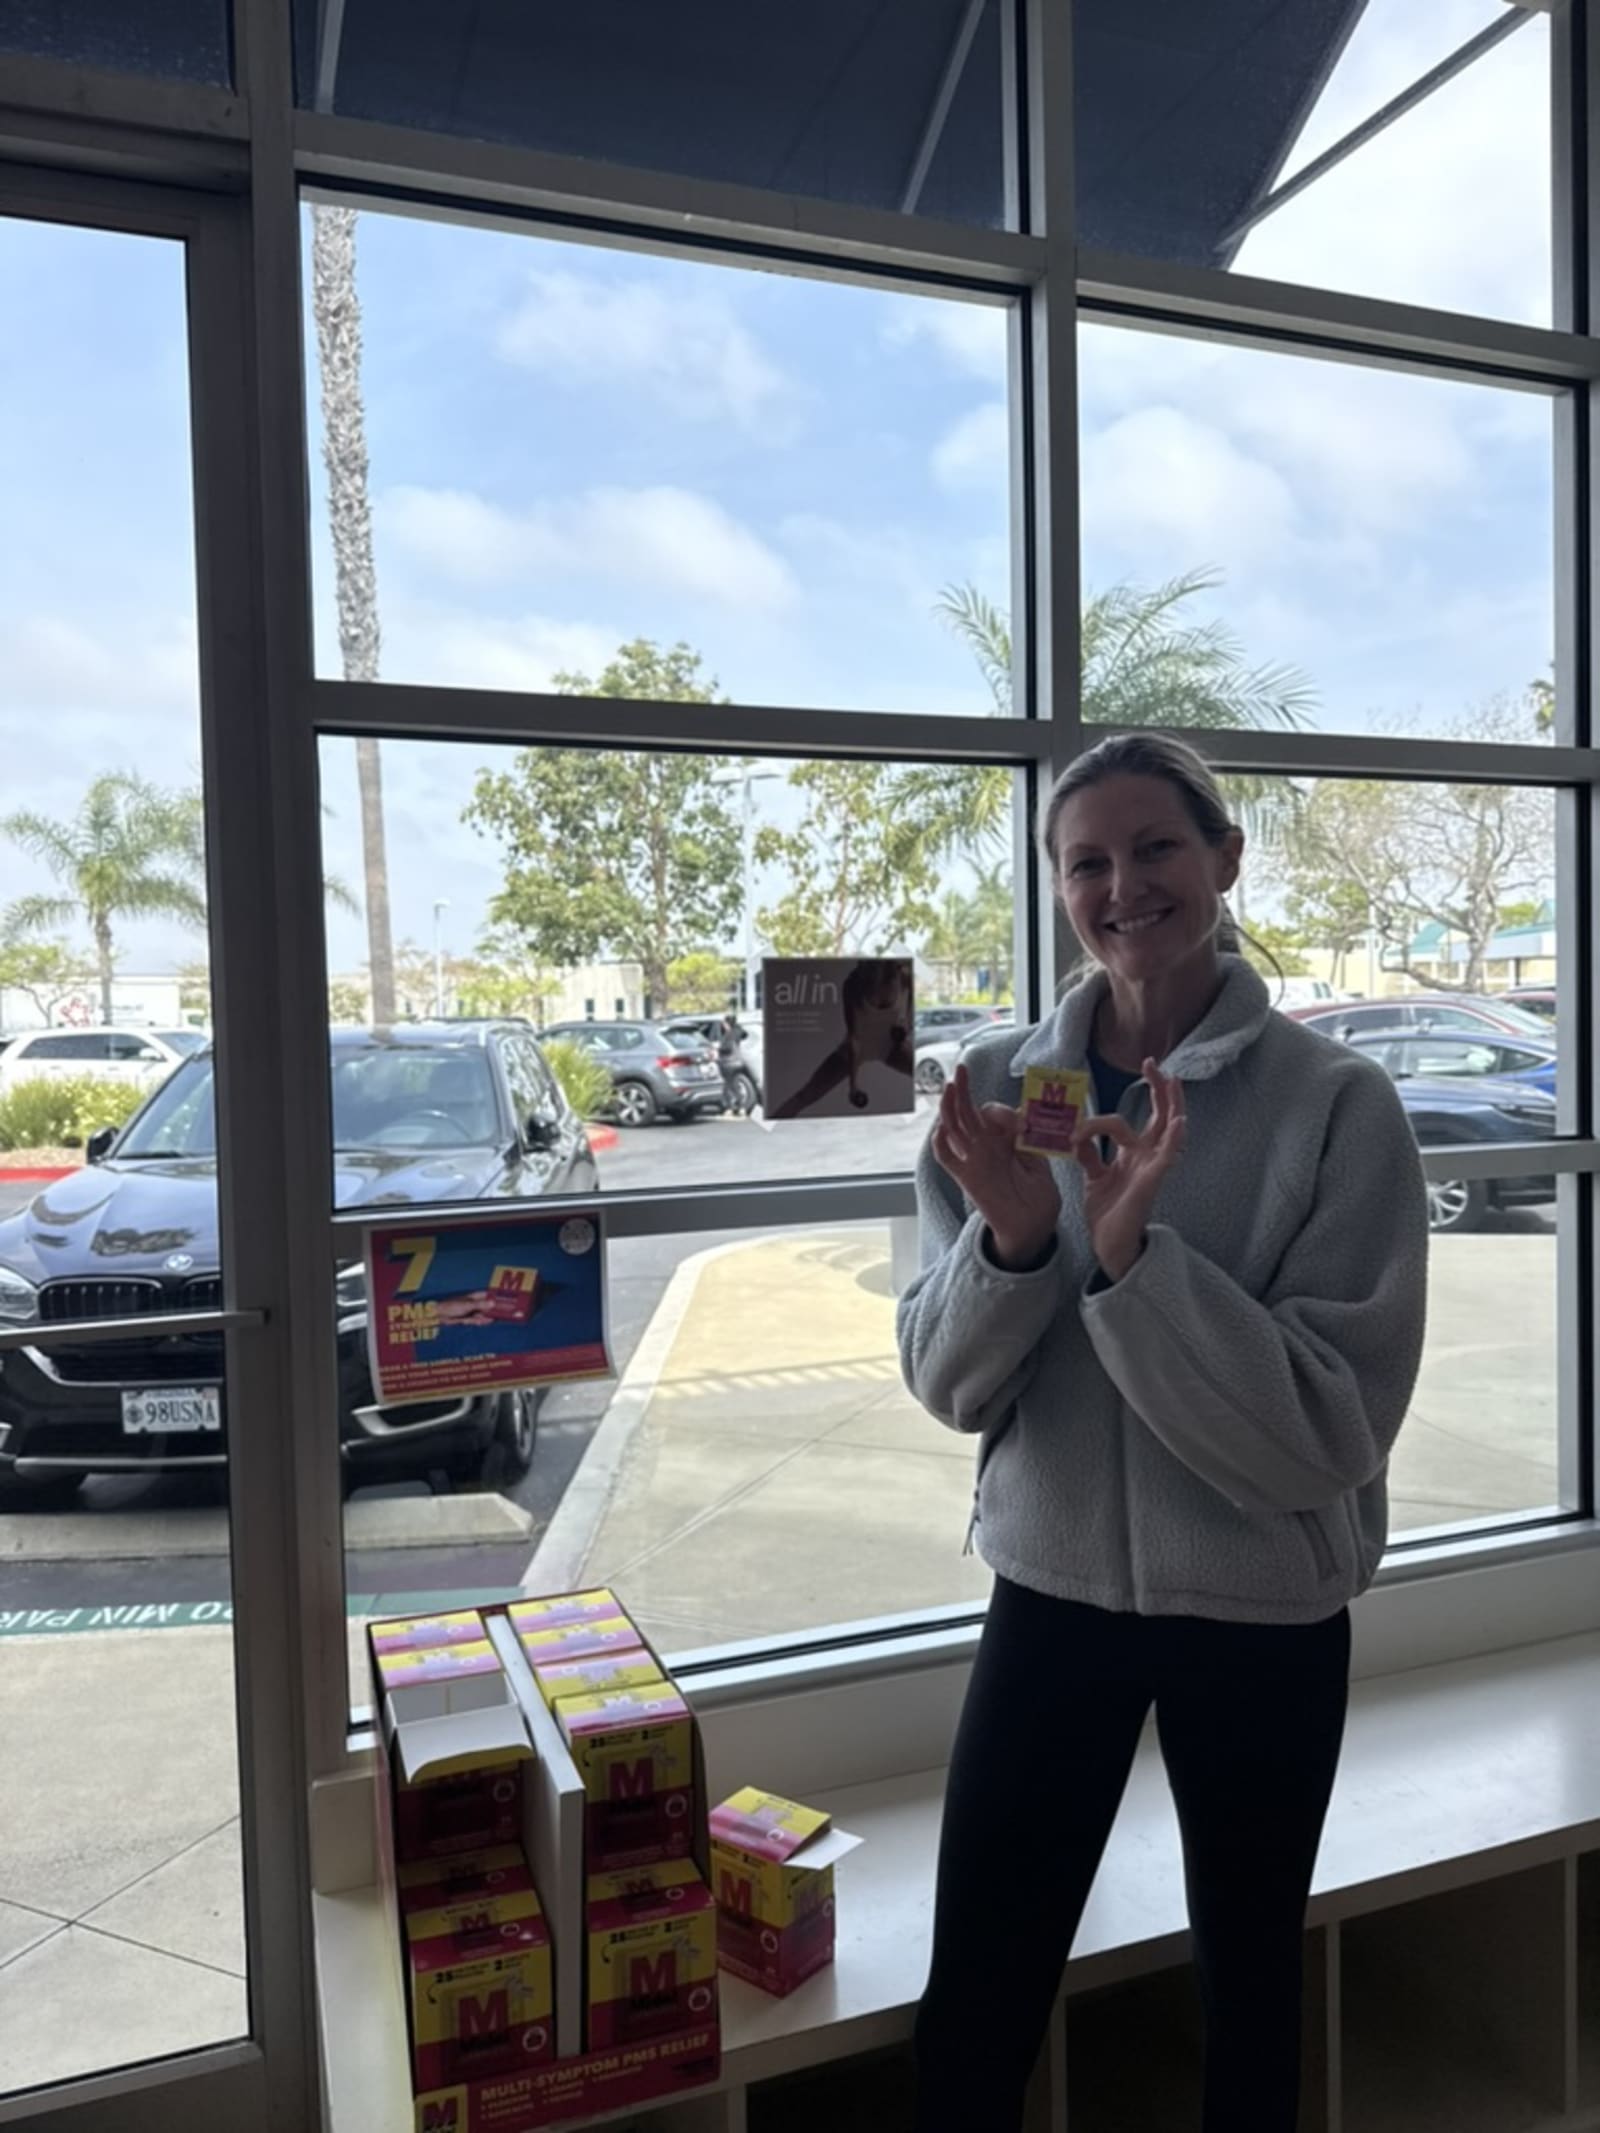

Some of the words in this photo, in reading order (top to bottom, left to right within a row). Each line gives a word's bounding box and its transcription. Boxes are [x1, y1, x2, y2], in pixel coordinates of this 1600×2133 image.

[775, 975, 808, 1005] all
[812, 974, 838, 1005] in
[392, 1237, 437, 1293] 7
[501, 1270, 526, 1292] M
[387, 1302, 439, 1324] PMS
[390, 1328, 441, 1345] RELIEF
[91, 1604, 178, 1624] MIN
[609, 1758, 656, 1804] M
[720, 1869, 753, 1919] M
[631, 1951, 678, 1999] M
[458, 1990, 509, 2042] M
[481, 2057, 620, 2101] MULTI-SYMPTOM
[623, 2049, 658, 2069] PMS
[660, 2033, 711, 2059] RELIEF
